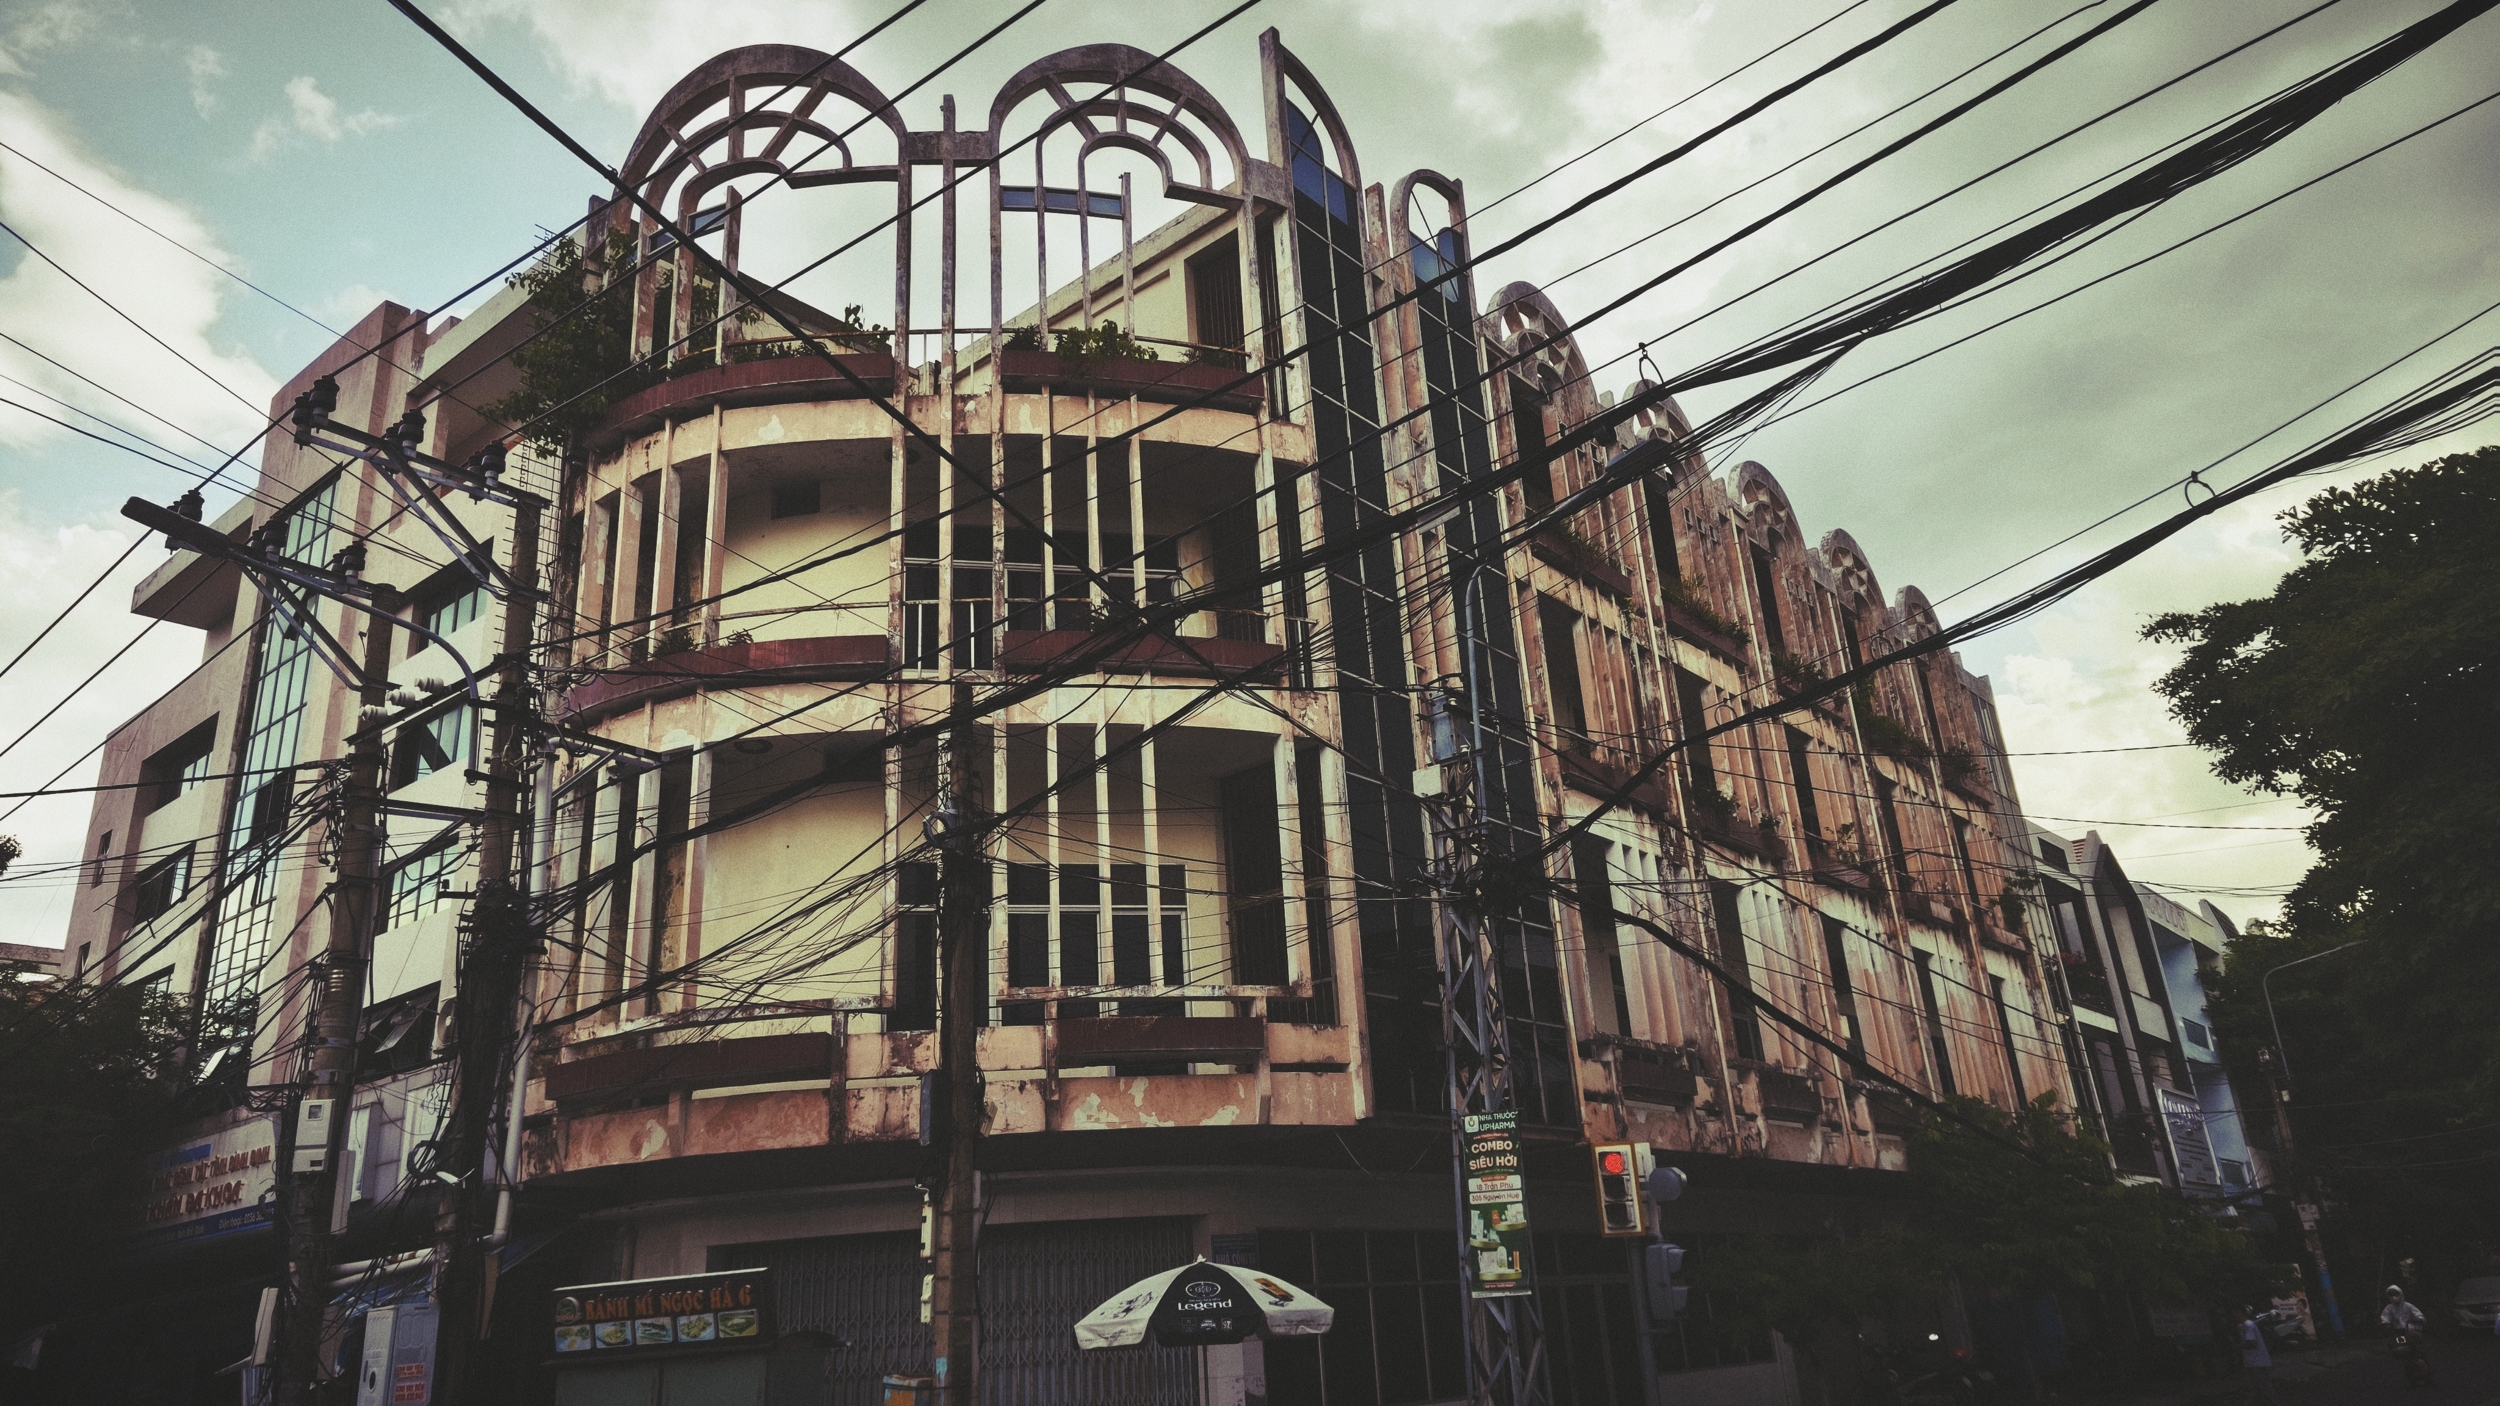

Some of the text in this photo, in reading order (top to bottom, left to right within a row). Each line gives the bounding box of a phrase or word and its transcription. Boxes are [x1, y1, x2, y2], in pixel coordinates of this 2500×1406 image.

[1480, 1120, 1516, 1131] UPHARMA
[1471, 1140, 1513, 1153] COMBO
[1469, 1153, 1517, 1170] SIÊU HỜI
[585, 1293, 629, 1321] BÁNH
[659, 1289, 704, 1315] NGỌC
[739, 1284, 752, 1307] 6
[1177, 1297, 1232, 1312] Legend
